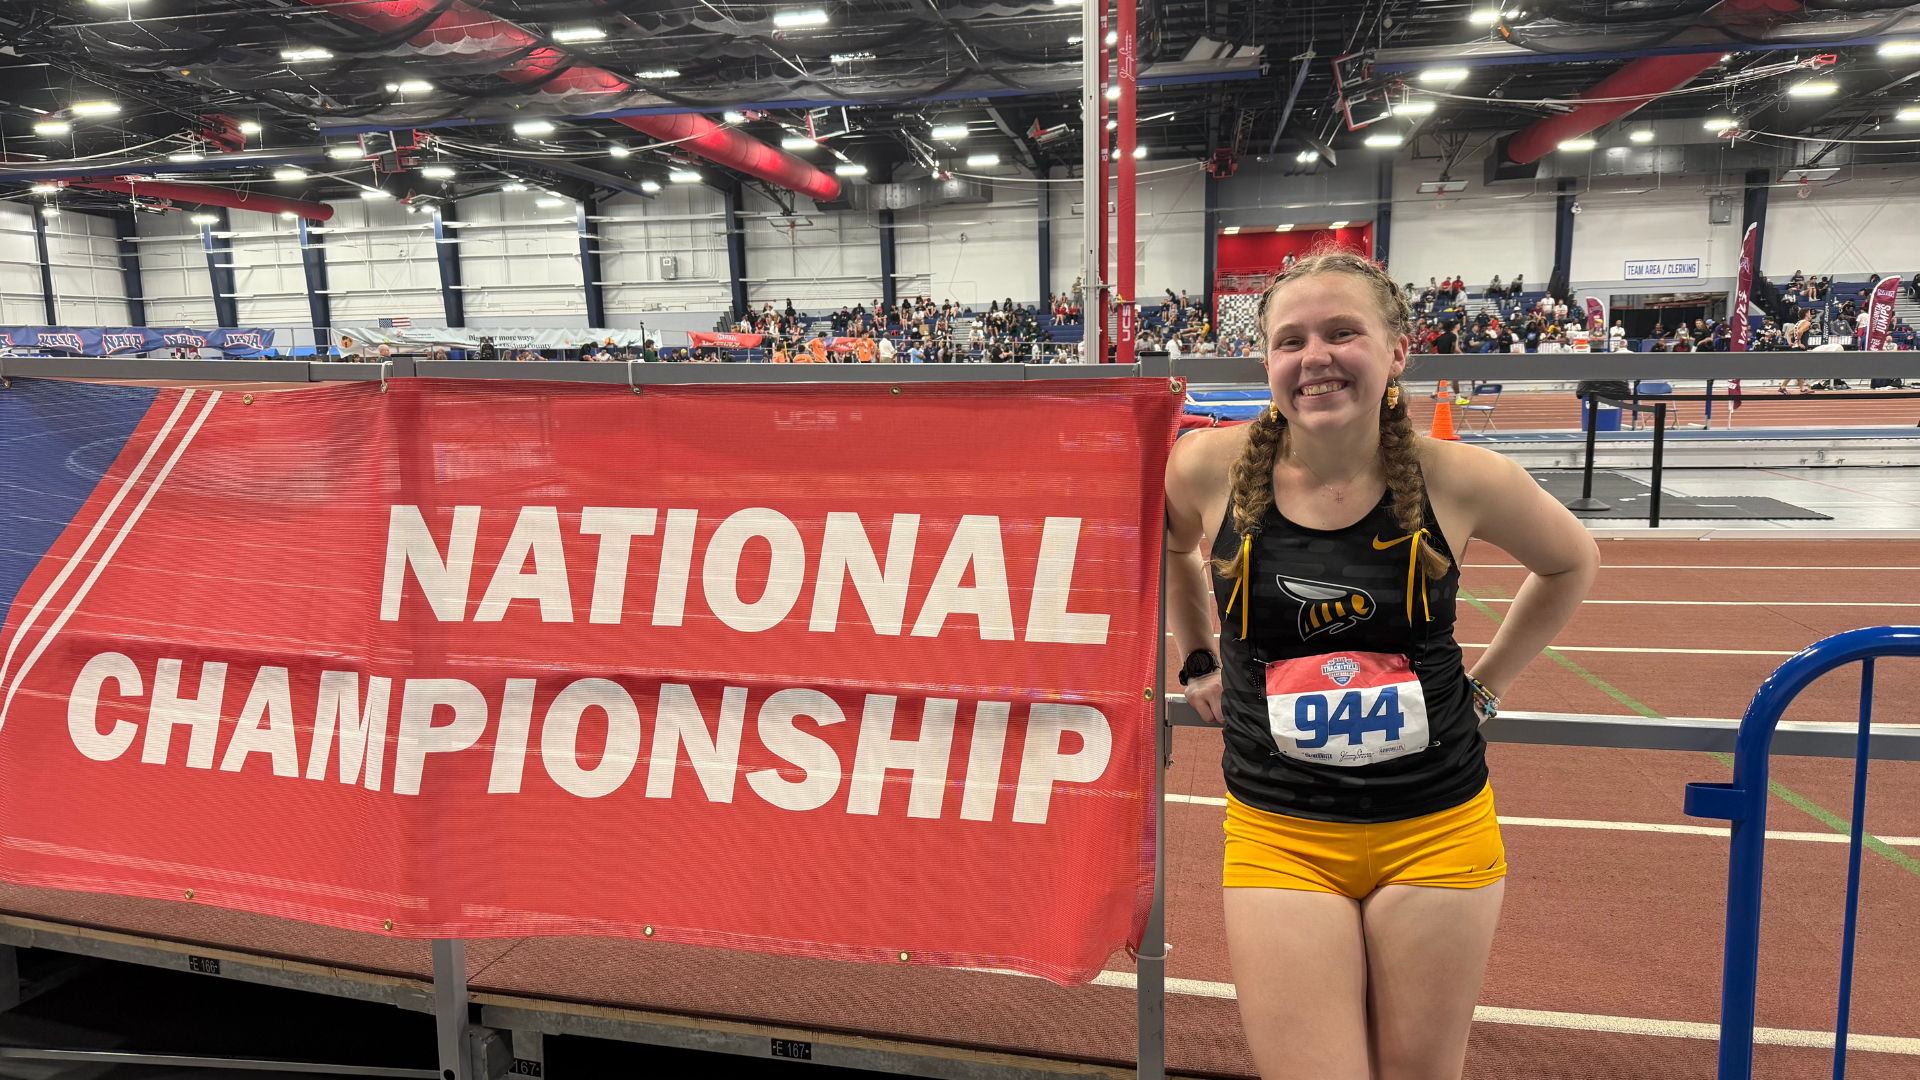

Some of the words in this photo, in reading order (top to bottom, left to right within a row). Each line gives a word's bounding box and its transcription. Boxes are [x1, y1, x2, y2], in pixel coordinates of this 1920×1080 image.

[1627, 265, 1644, 275] TEAM
[1645, 264, 1661, 275] AREA
[1662, 264, 1667, 275] /
[1668, 263, 1697, 274] CLERKING
[1122, 304, 1131, 342] UCS
[1876, 304, 1892, 334] JUMPS
[102, 333, 145, 355] NAIA
[224, 333, 264, 350] NAIA
[380, 505, 1110, 644] NATIONAL
[1295, 686, 1404, 748] 944
[67, 652, 1112, 824] CHAMPIONSHIP
[193, 957, 200, 970] E
[201, 959, 216, 973] 166
[776, 1041, 784, 1056] E
[787, 1042, 805, 1058] 167
[513, 1060, 537, 1075] 167
